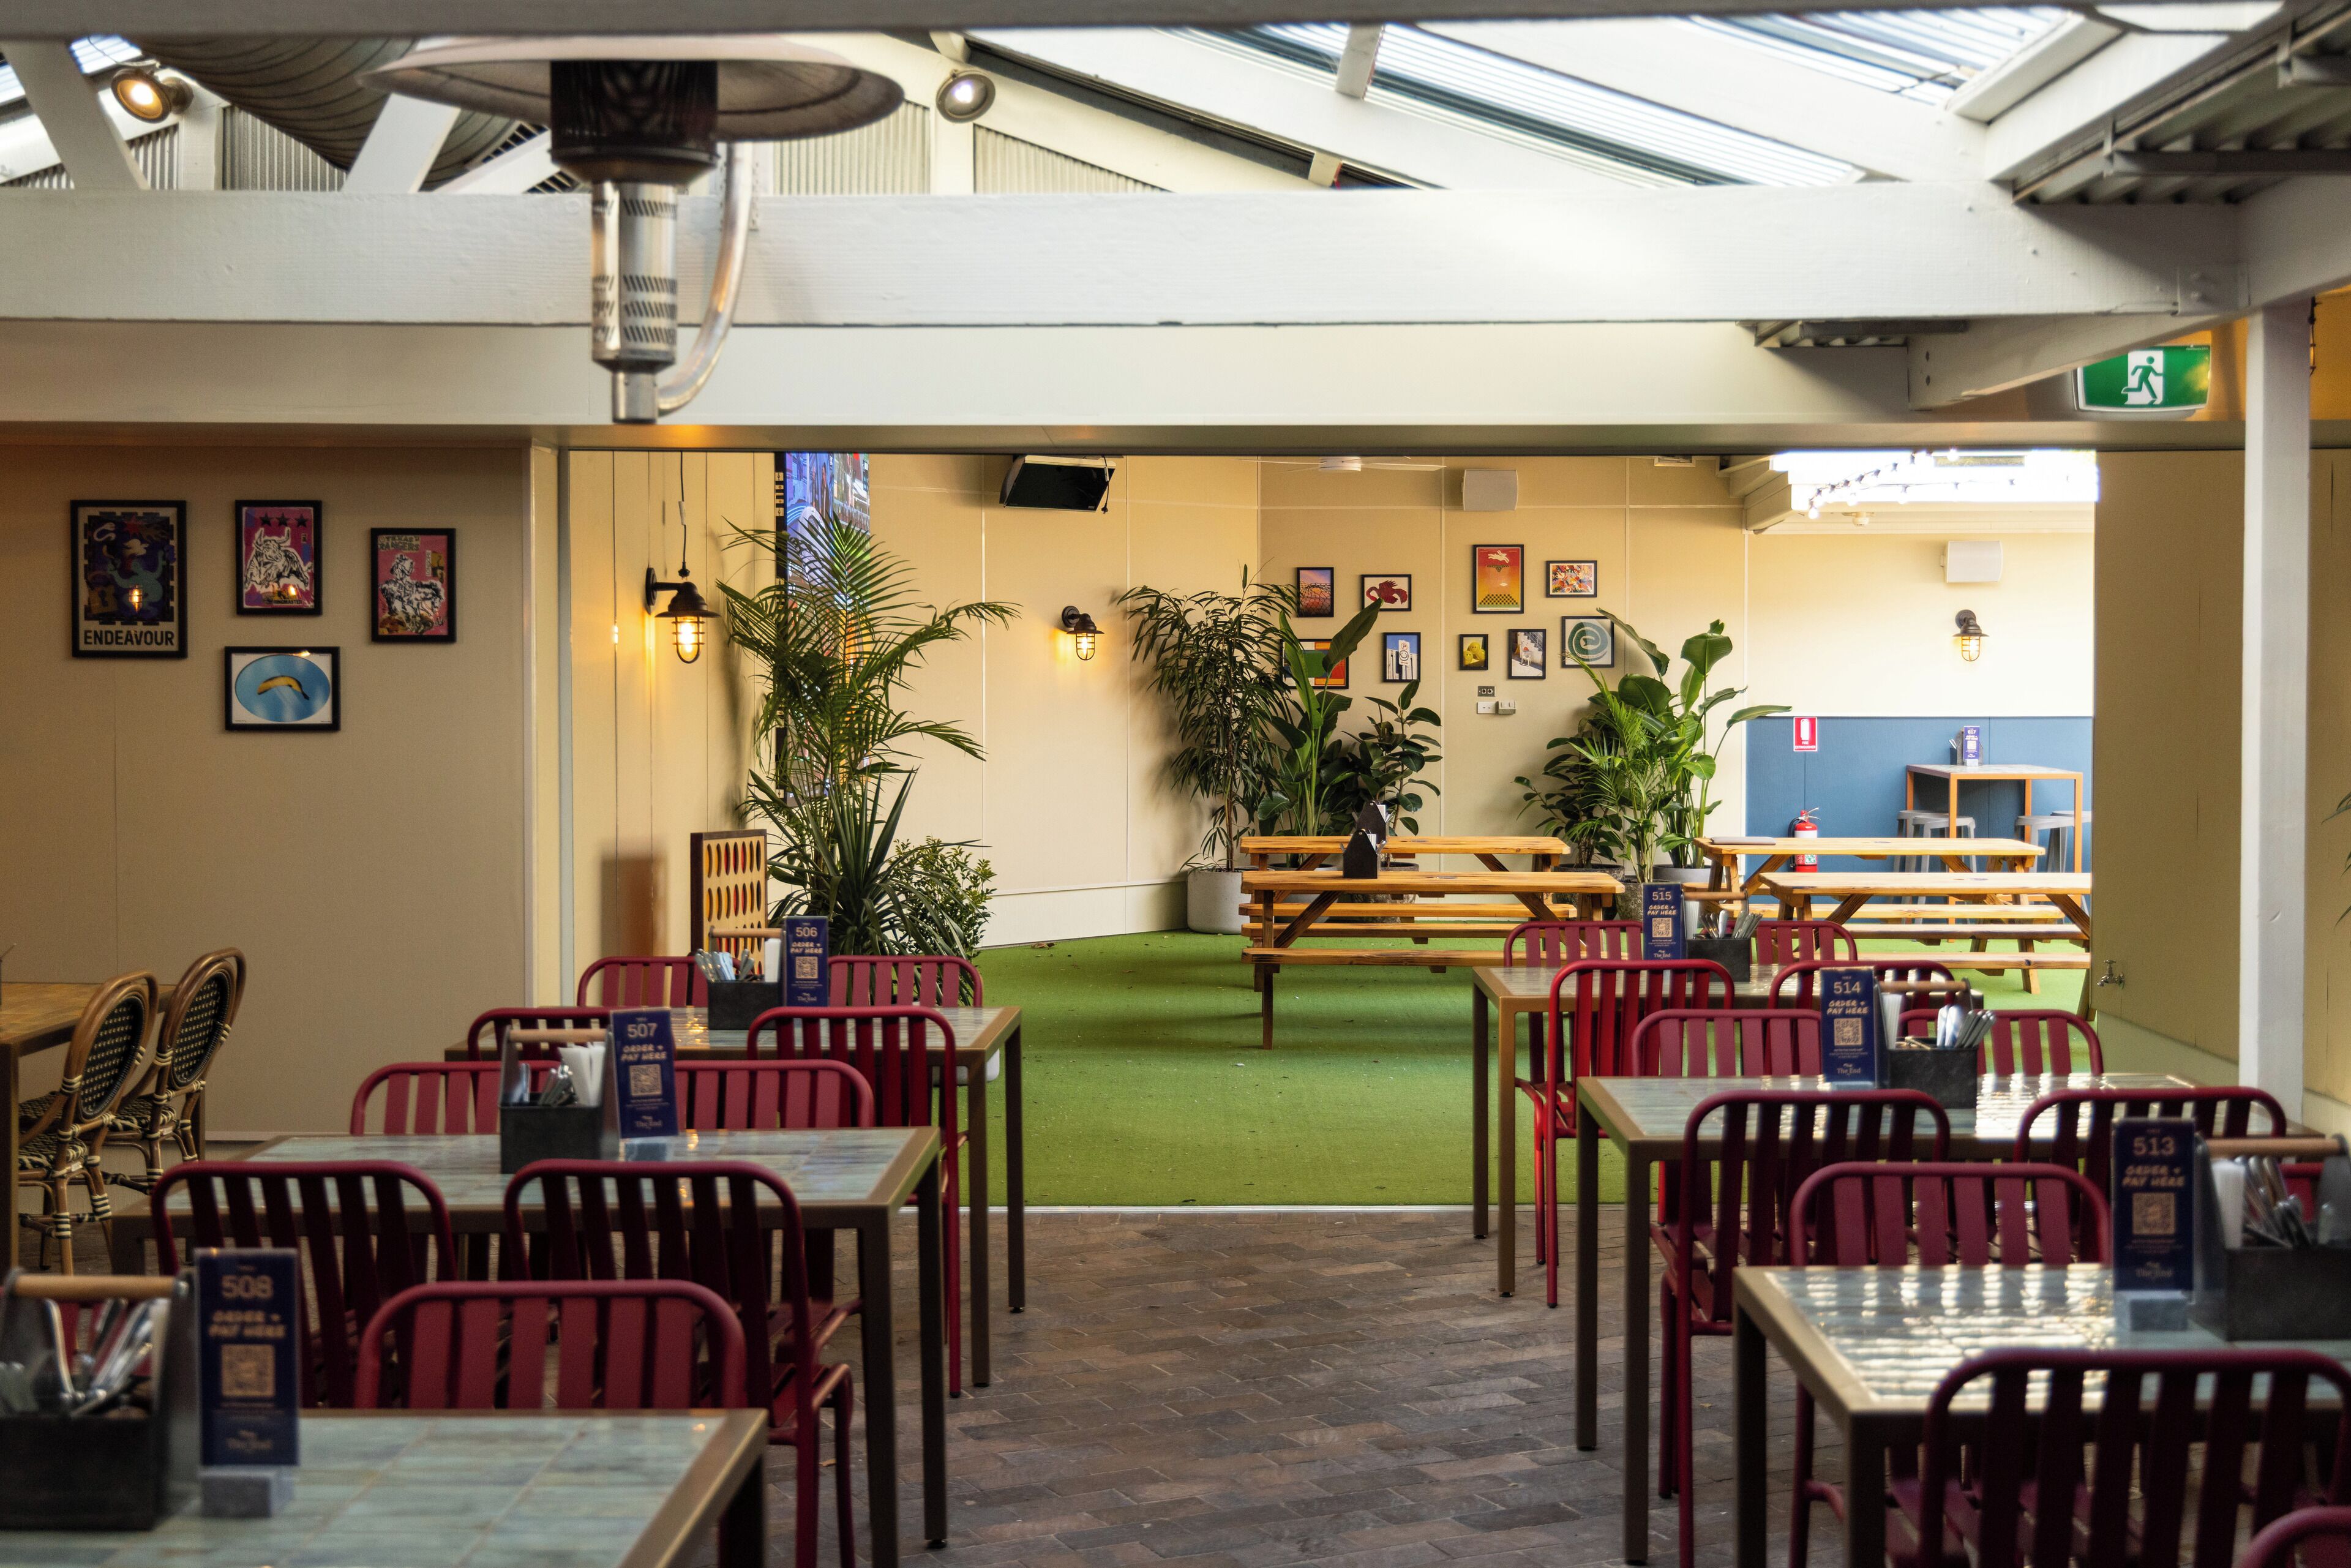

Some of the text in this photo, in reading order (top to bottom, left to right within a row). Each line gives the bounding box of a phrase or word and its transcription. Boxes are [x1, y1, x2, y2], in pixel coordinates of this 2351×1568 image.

[83, 629, 174, 646] ENDEAVOUR
[1652, 891, 1671, 901] 515
[795, 926, 818, 937] 506
[1833, 981, 1861, 994] 514
[1828, 999, 1858, 1008] ORDER
[627, 1022, 658, 1039] 507
[622, 1043, 655, 1054] ORDER
[620, 1051, 667, 1062] PAY HERE
[2132, 1136, 2175, 1157] 513
[221, 1274, 274, 1300] 508
